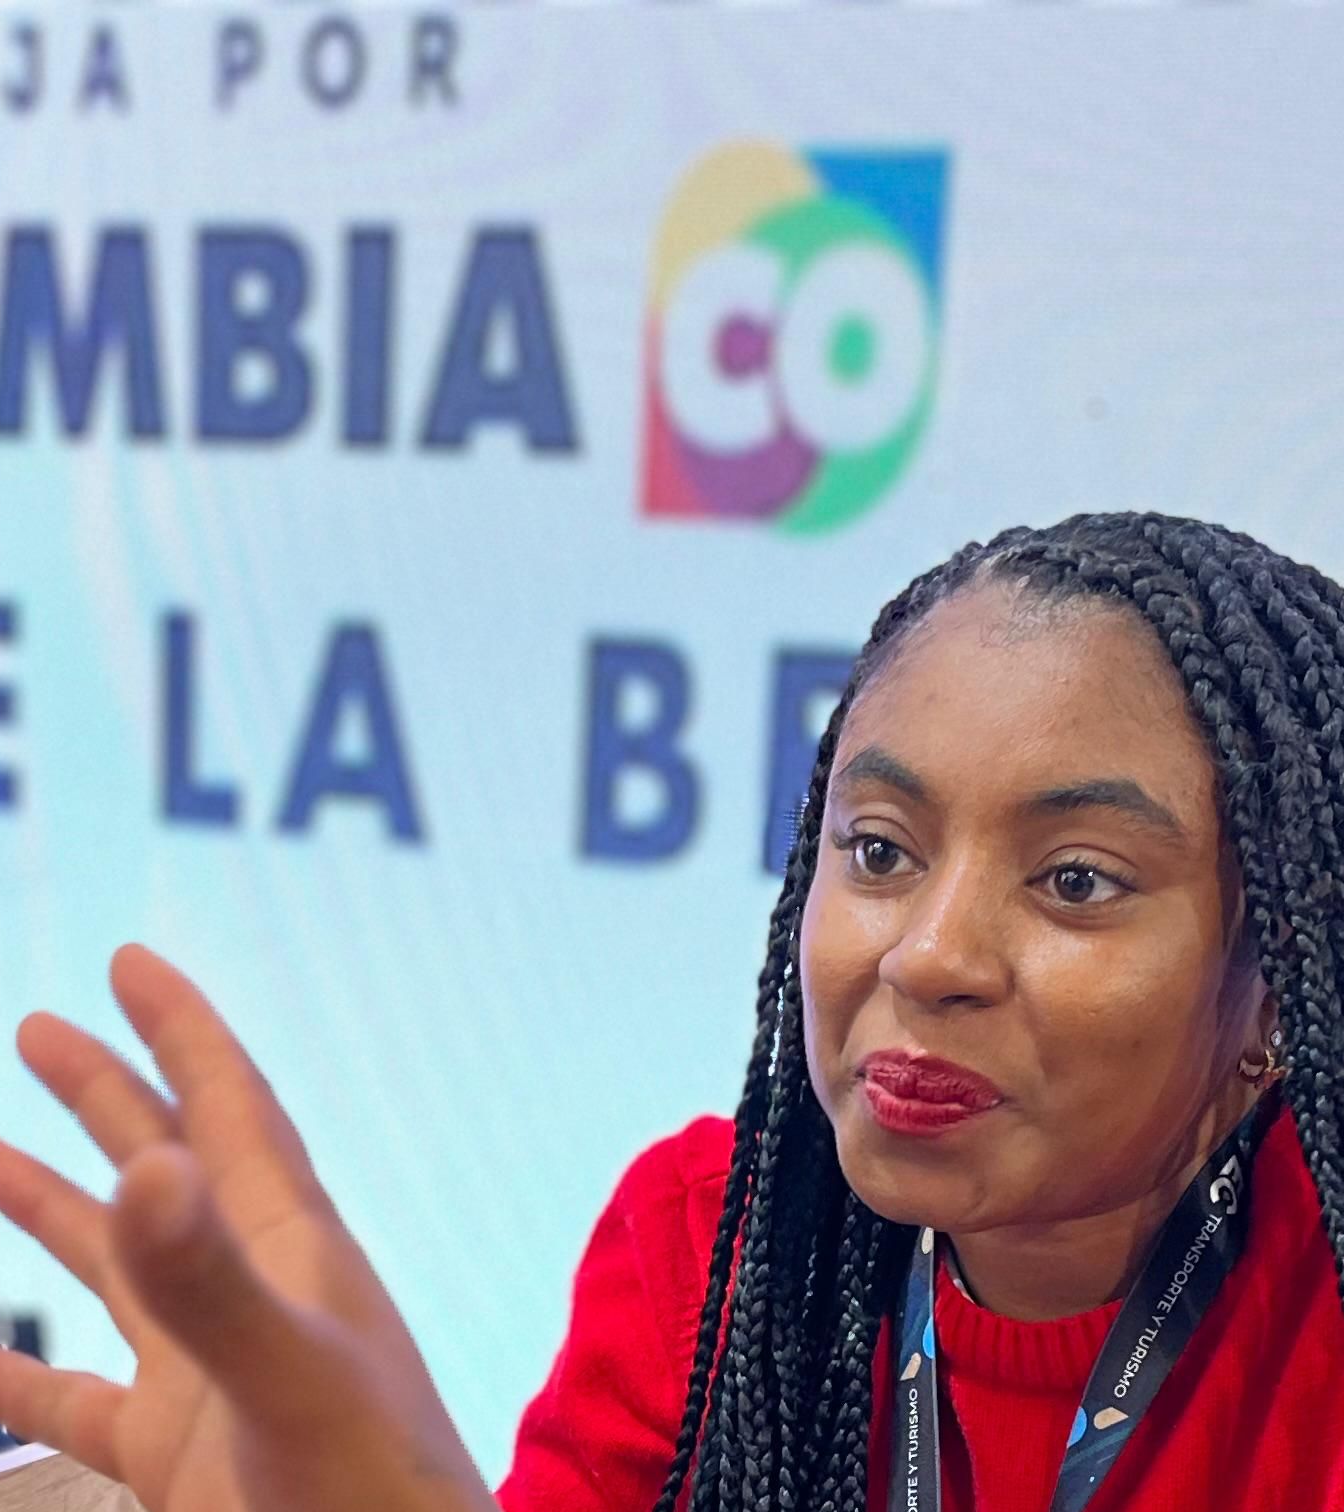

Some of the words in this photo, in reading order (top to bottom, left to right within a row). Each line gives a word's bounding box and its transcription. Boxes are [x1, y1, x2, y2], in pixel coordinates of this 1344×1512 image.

[216, 14, 464, 110] POR
[160, 608, 429, 846] LA
[1156, 1213, 1223, 1313] TRANSPORTE
[1151, 1315, 1165, 1328] Y
[1113, 1327, 1158, 1399] TURISMO
[907, 1388, 919, 1462] TURISMO
[907, 1464, 919, 1475] Y
